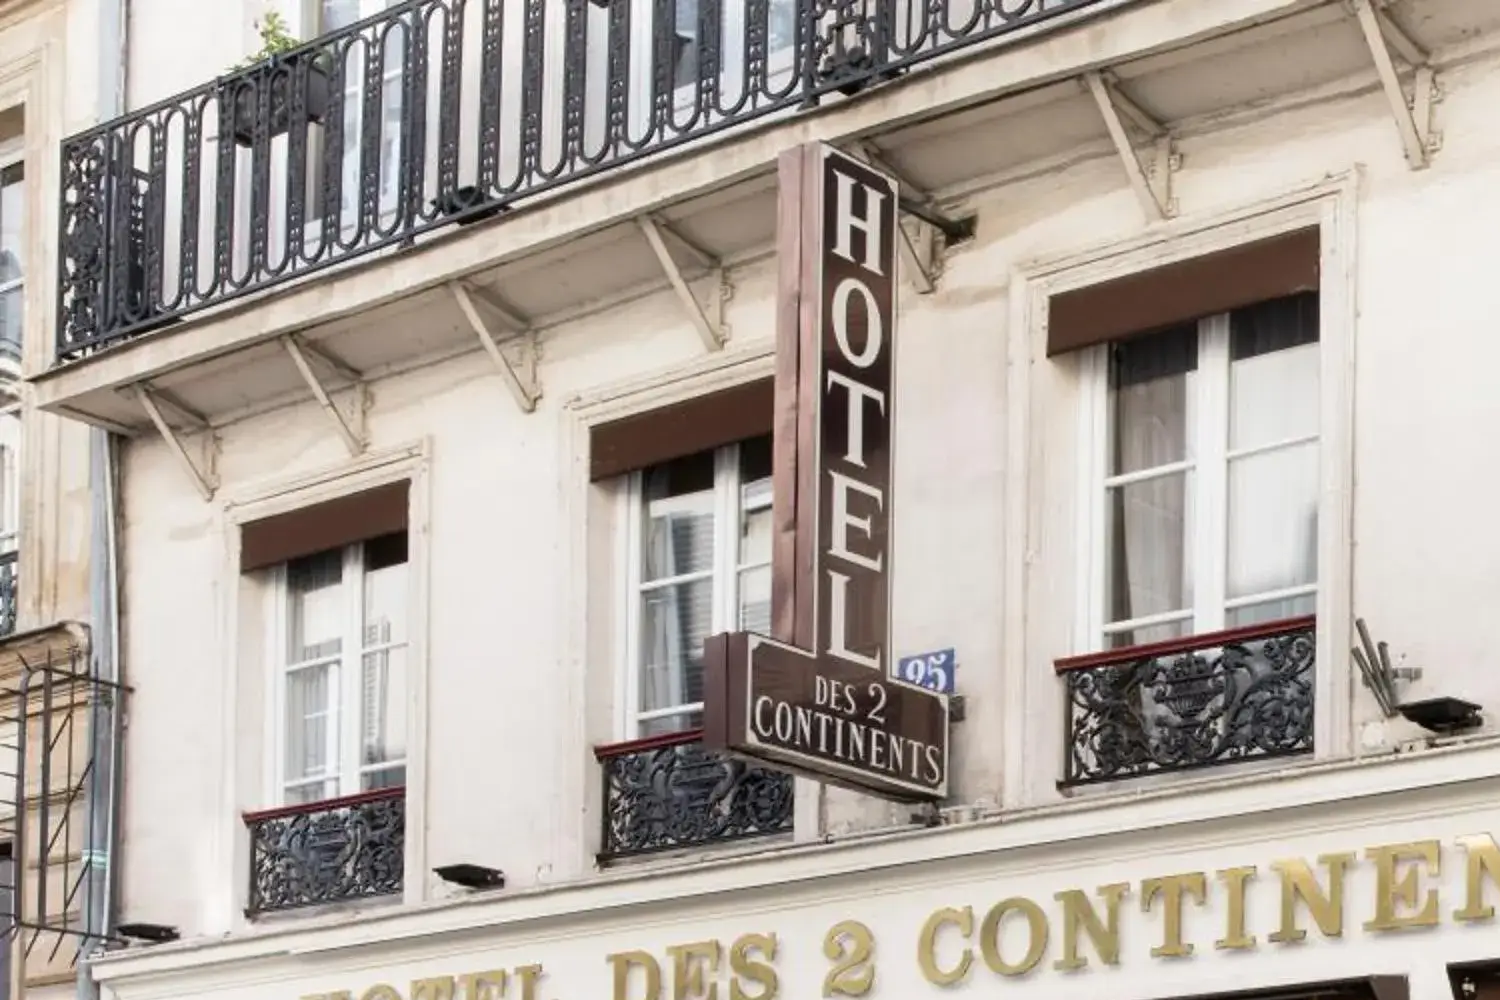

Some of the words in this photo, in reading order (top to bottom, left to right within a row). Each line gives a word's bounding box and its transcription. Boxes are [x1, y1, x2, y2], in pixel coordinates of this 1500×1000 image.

[827, 168, 887, 673] HOTEL
[754, 695, 942, 785] CONTINENTS
[815, 674, 859, 715] DES
[867, 682, 887, 725] 2
[822, 919, 877, 1000] 2
